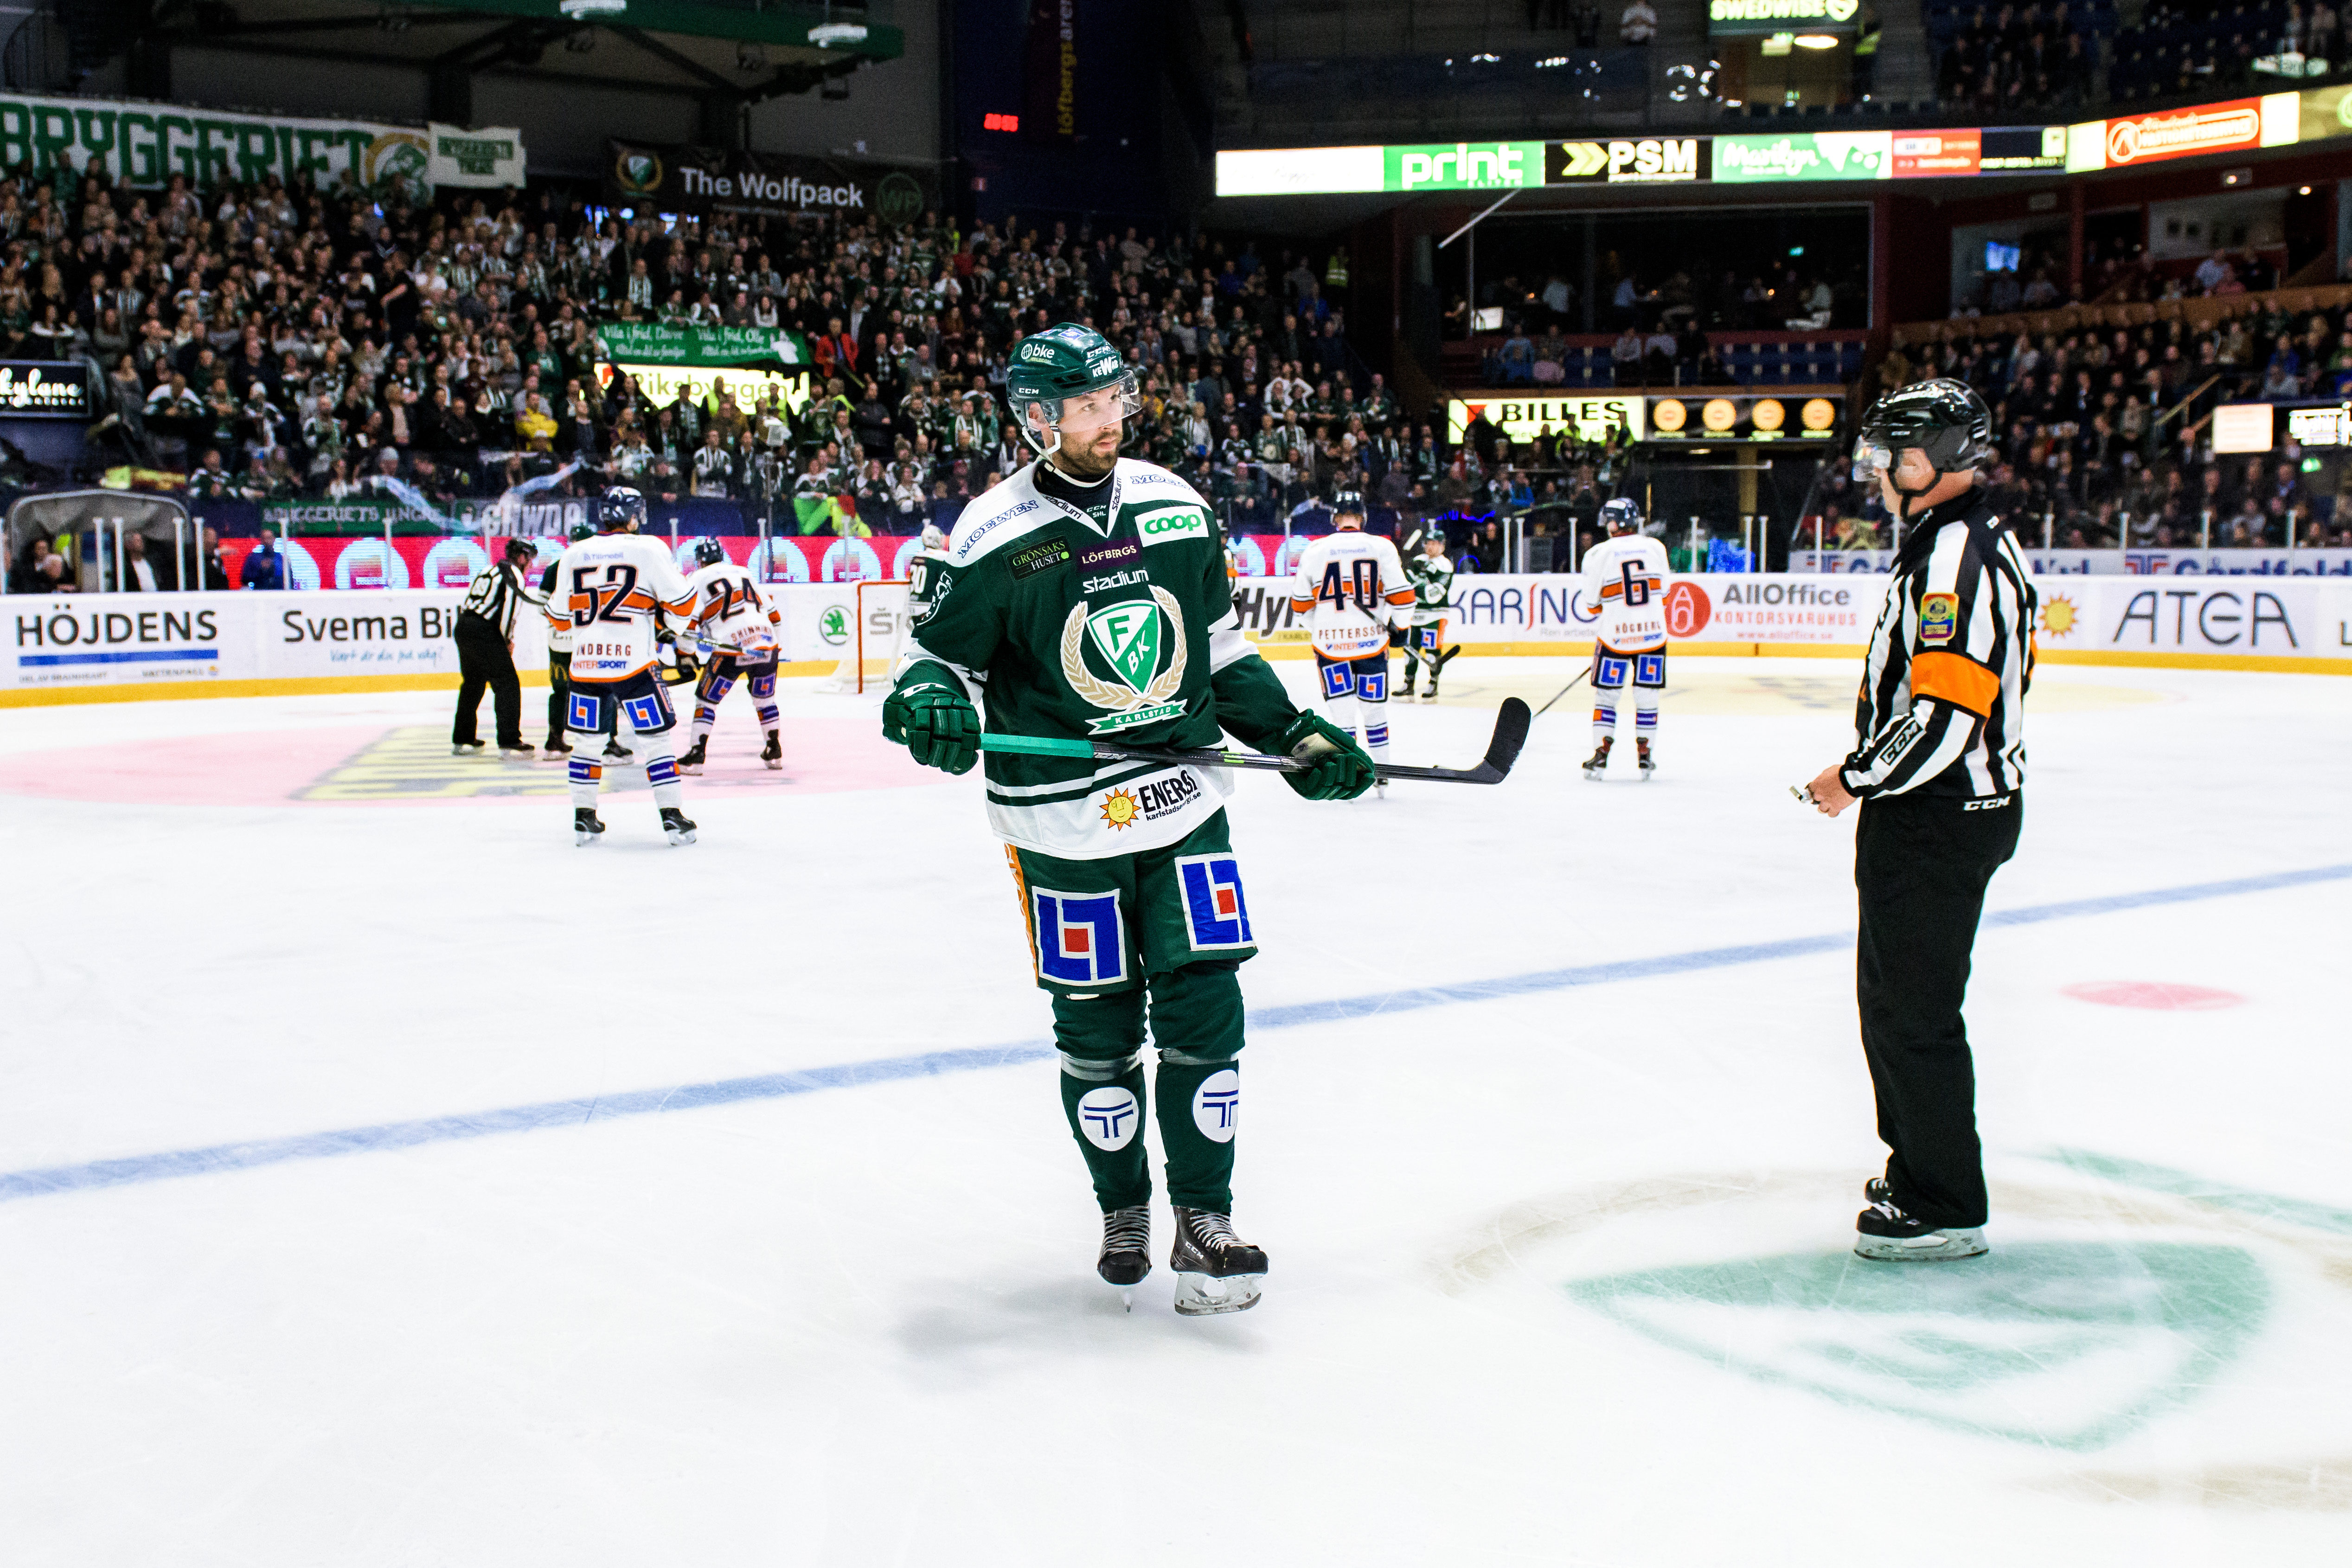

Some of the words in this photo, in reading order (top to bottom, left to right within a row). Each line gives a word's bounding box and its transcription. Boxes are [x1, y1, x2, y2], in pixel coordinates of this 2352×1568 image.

[0, 102, 374, 187] BRYGGERIET
[1608, 139, 1697, 174] PSM
[1402, 143, 1523, 190] print
[679, 166, 733, 197] The
[739, 172, 864, 210] Wolfpack
[1032, 344, 1055, 358] bke
[1087, 346, 1111, 358] CCM
[1502, 402, 1625, 422] BILLES
[1043, 494, 1083, 519] stadium
[1112, 477, 1122, 512] stadium
[1086, 505, 1107, 513] CCM
[957, 499, 1039, 559] MOELVEN
[1144, 514, 1201, 535] coop
[1013, 540, 1066, 567] GRÖNSAKS
[1031, 551, 1061, 570] HUSET
[1082, 545, 1137, 564] LÖFBERGS
[1083, 570, 1149, 594] stadium
[1319, 557, 1381, 614] 40
[1621, 559, 1649, 608] 6
[1723, 583, 1851, 606] AllOffice
[572, 563, 638, 629] 52
[707, 577, 761, 623] 24
[16, 603, 218, 646] HÖJDENS
[282, 609, 409, 643] Svema
[419, 605, 461, 640] Bi
[1714, 611, 1857, 627] KONTORSVARUHUS
[1115, 707, 1172, 725] KARLSTAD
[1286, 720, 1301, 736] CCM
[1882, 723, 1921, 762] CCM
[1963, 796, 2011, 812] CCM
[1185, 1241, 1204, 1260] CCM
